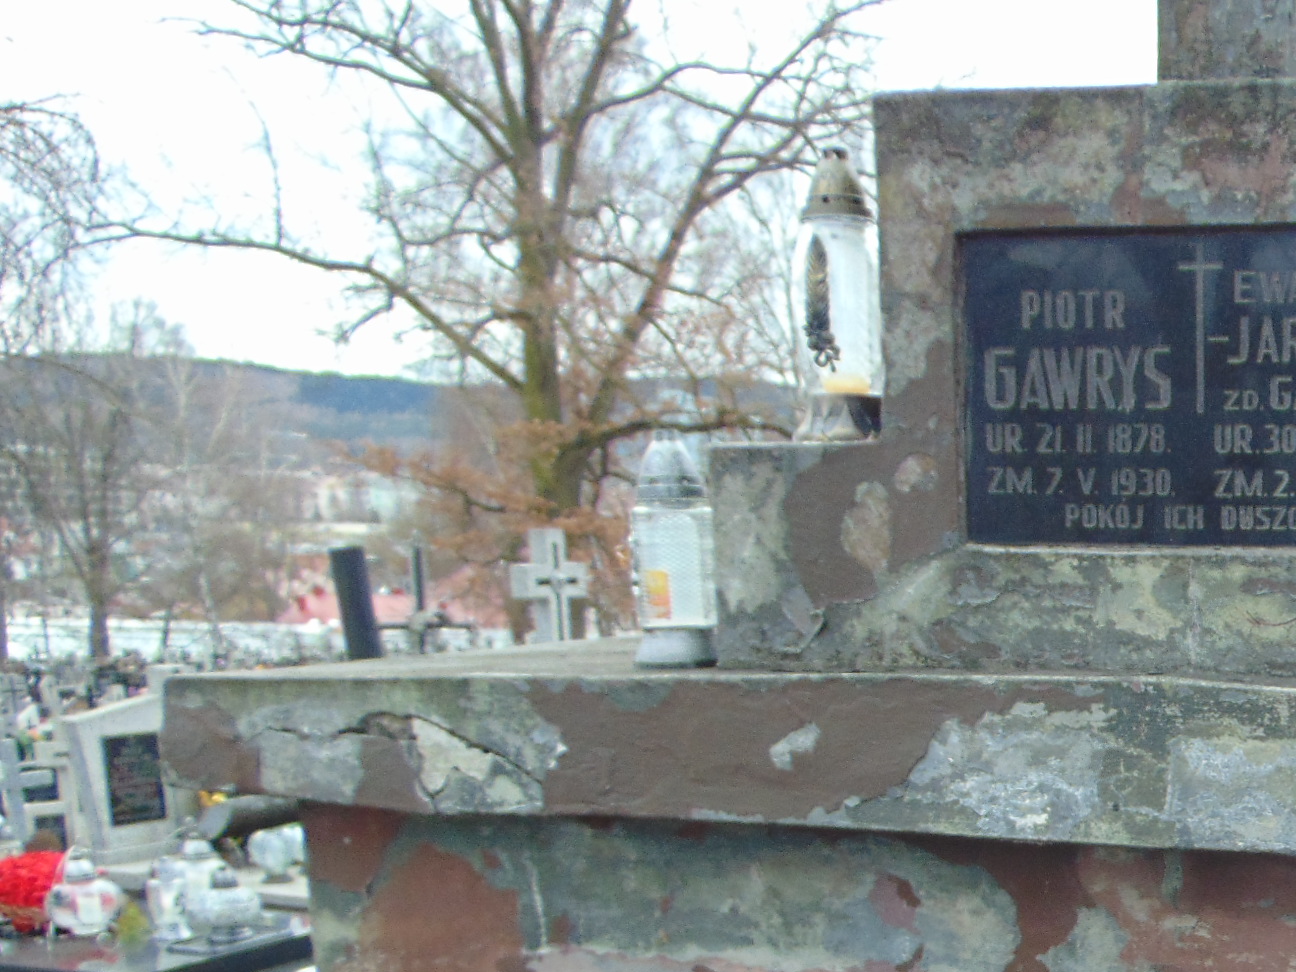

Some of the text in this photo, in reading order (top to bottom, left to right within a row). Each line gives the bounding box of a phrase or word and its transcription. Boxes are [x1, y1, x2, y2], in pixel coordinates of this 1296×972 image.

[1020, 289, 1126, 330] PIOTR
[1213, 468, 1268, 498] ZM.
[1272, 469, 1296, 498] 2.
[1163, 504, 1204, 531] ICH
